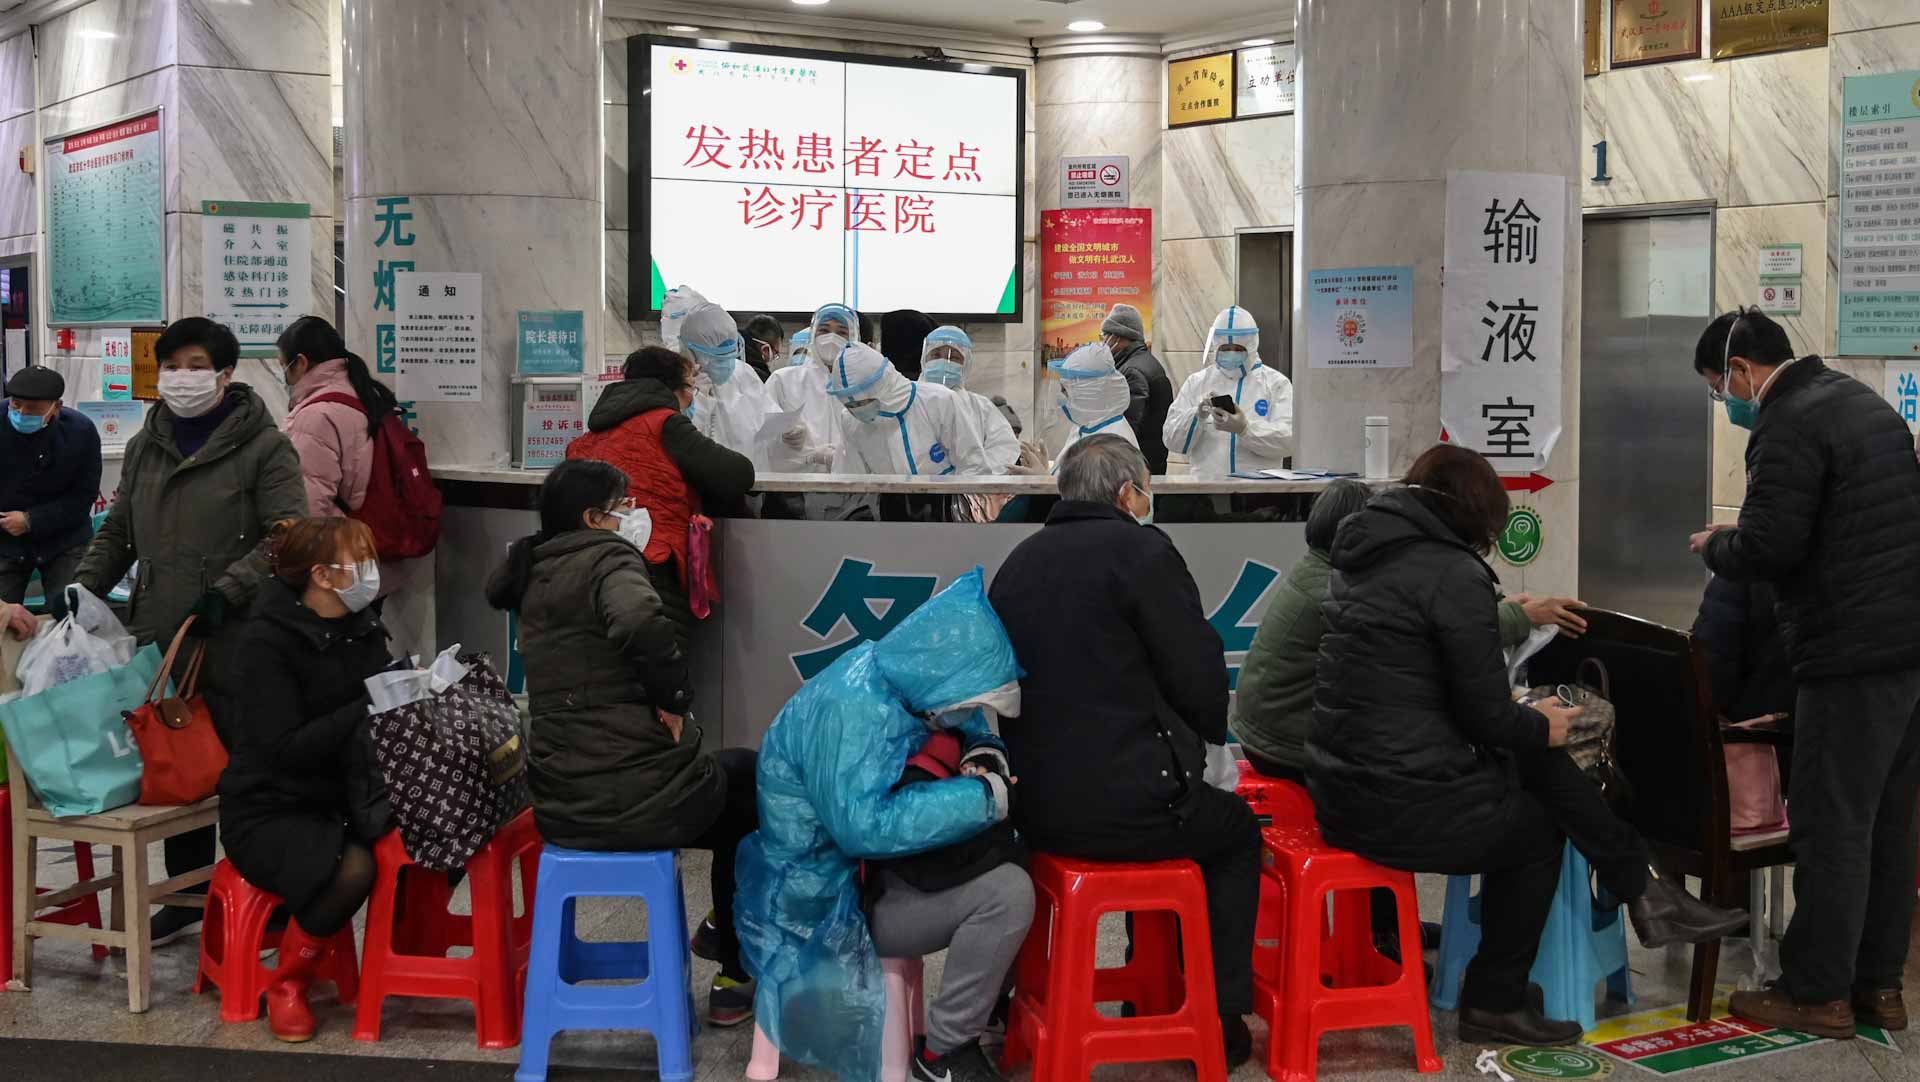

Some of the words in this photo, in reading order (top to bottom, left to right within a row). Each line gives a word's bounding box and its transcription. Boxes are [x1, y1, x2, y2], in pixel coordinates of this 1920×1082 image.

[683, 124, 983, 183] 发热患者定点
[1590, 140, 1613, 182] 1
[738, 185, 936, 234] 诊疗医院
[223, 223, 289, 235] 磁共振
[223, 240, 289, 251] 介入室
[1054, 243, 1119, 253] 建设全国文明城市
[223, 255, 289, 267] 住院部通道
[1069, 254, 1136, 264] 做文明有礼武汉人
[223, 271, 289, 282] 感染科门诊
[223, 287, 289, 298] 发热门诊
[418, 284, 456, 297] 通知
[239, 322, 289, 335] 无障碍通
[1480, 198, 1541, 458] 输液室
[525, 329, 577, 345] 院长接待日
[1897, 372, 1919, 422] 治
